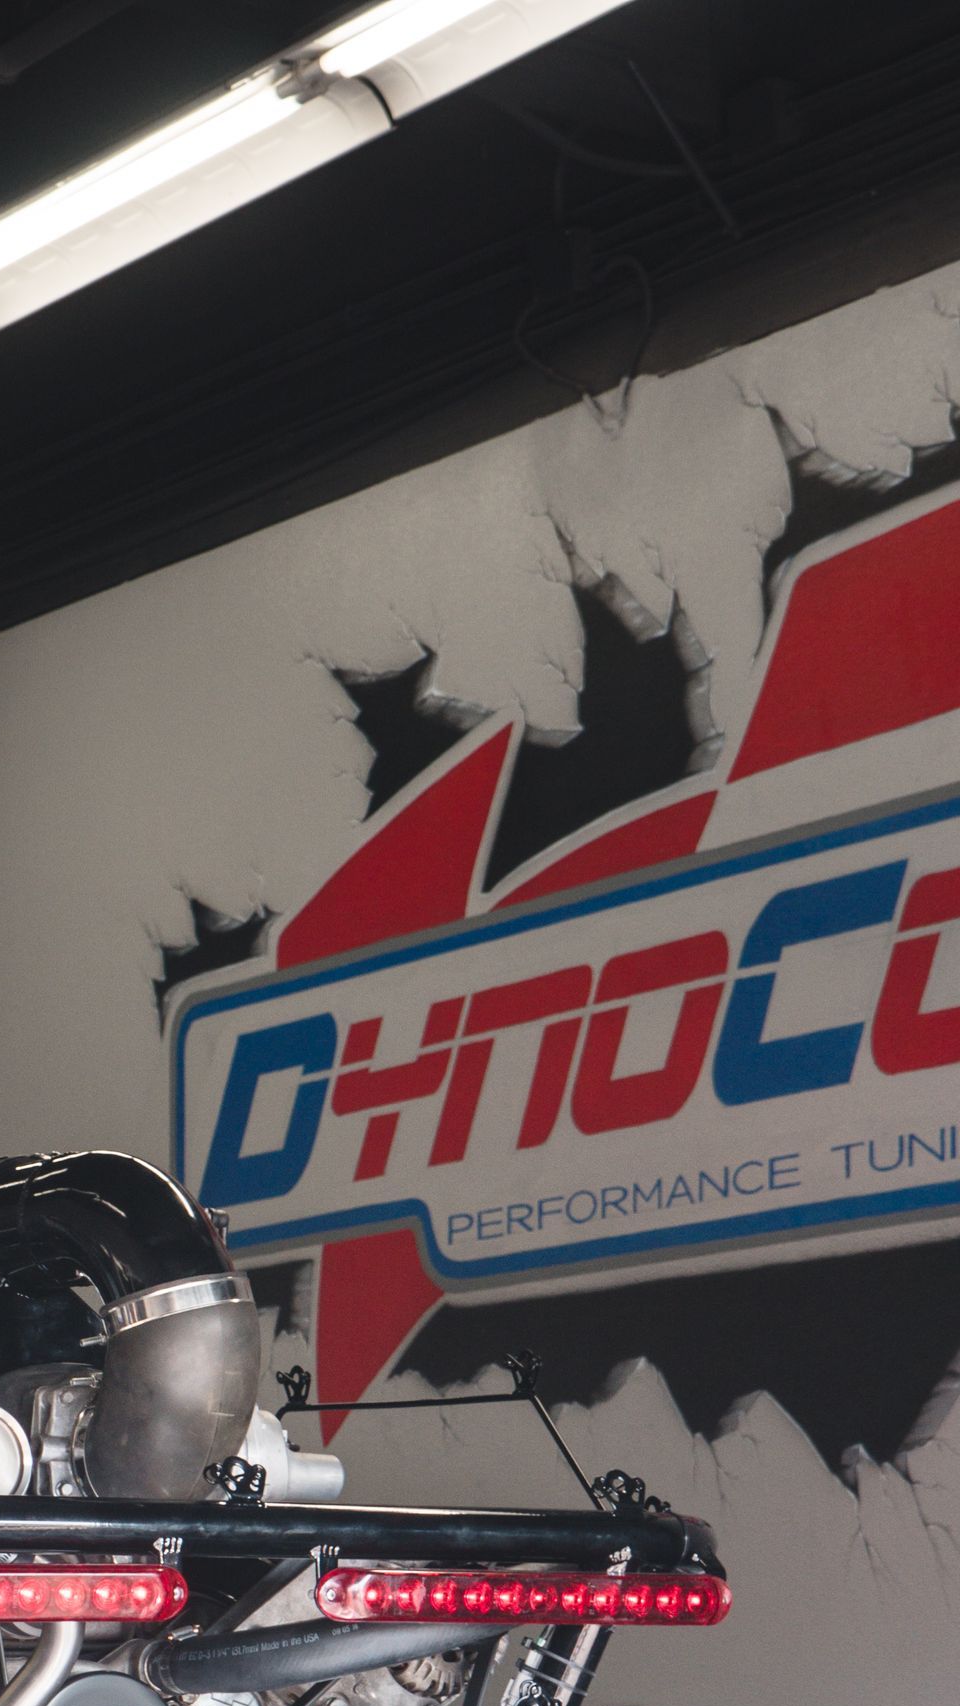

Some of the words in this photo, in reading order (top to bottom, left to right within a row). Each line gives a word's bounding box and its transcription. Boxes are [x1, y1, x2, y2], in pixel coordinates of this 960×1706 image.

[446, 1153, 801, 1245] PERFORMANCE
[830, 1126, 957, 1179] TUNI
[303, 1633, 320, 1645] USA
